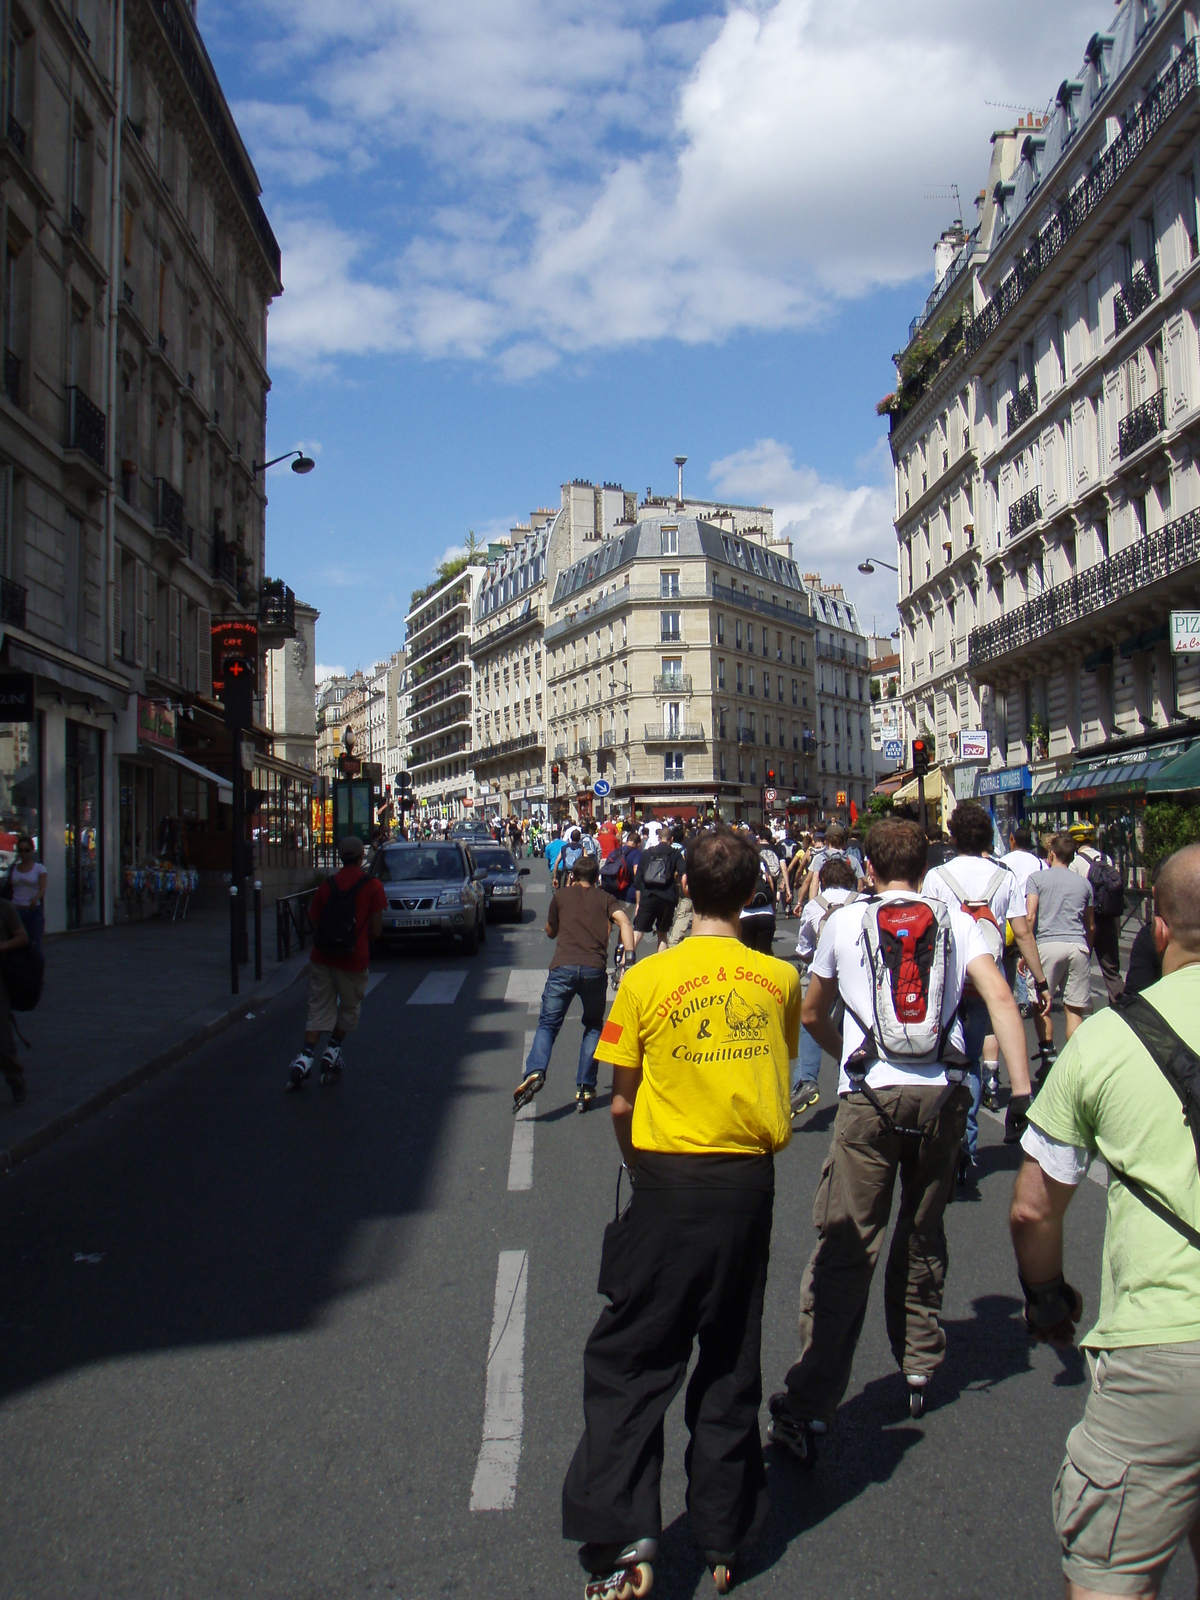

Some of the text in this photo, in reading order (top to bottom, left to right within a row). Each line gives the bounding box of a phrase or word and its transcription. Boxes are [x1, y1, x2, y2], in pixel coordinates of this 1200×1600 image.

[1175, 639, 1187, 651] La
[964, 747, 984, 755] SNCF
[963, 767, 971, 777] Le
[961, 781, 974, 793] Pied
[980, 771, 1020, 792] CENTRALE VOYAGES
[671, 787, 699, 795] Boulanger
[656, 966, 785, 1018] Urgence & Secours
[669, 993, 726, 1028] Rollers
[696, 1018, 713, 1040] &
[671, 1044, 770, 1065] Coquillages
